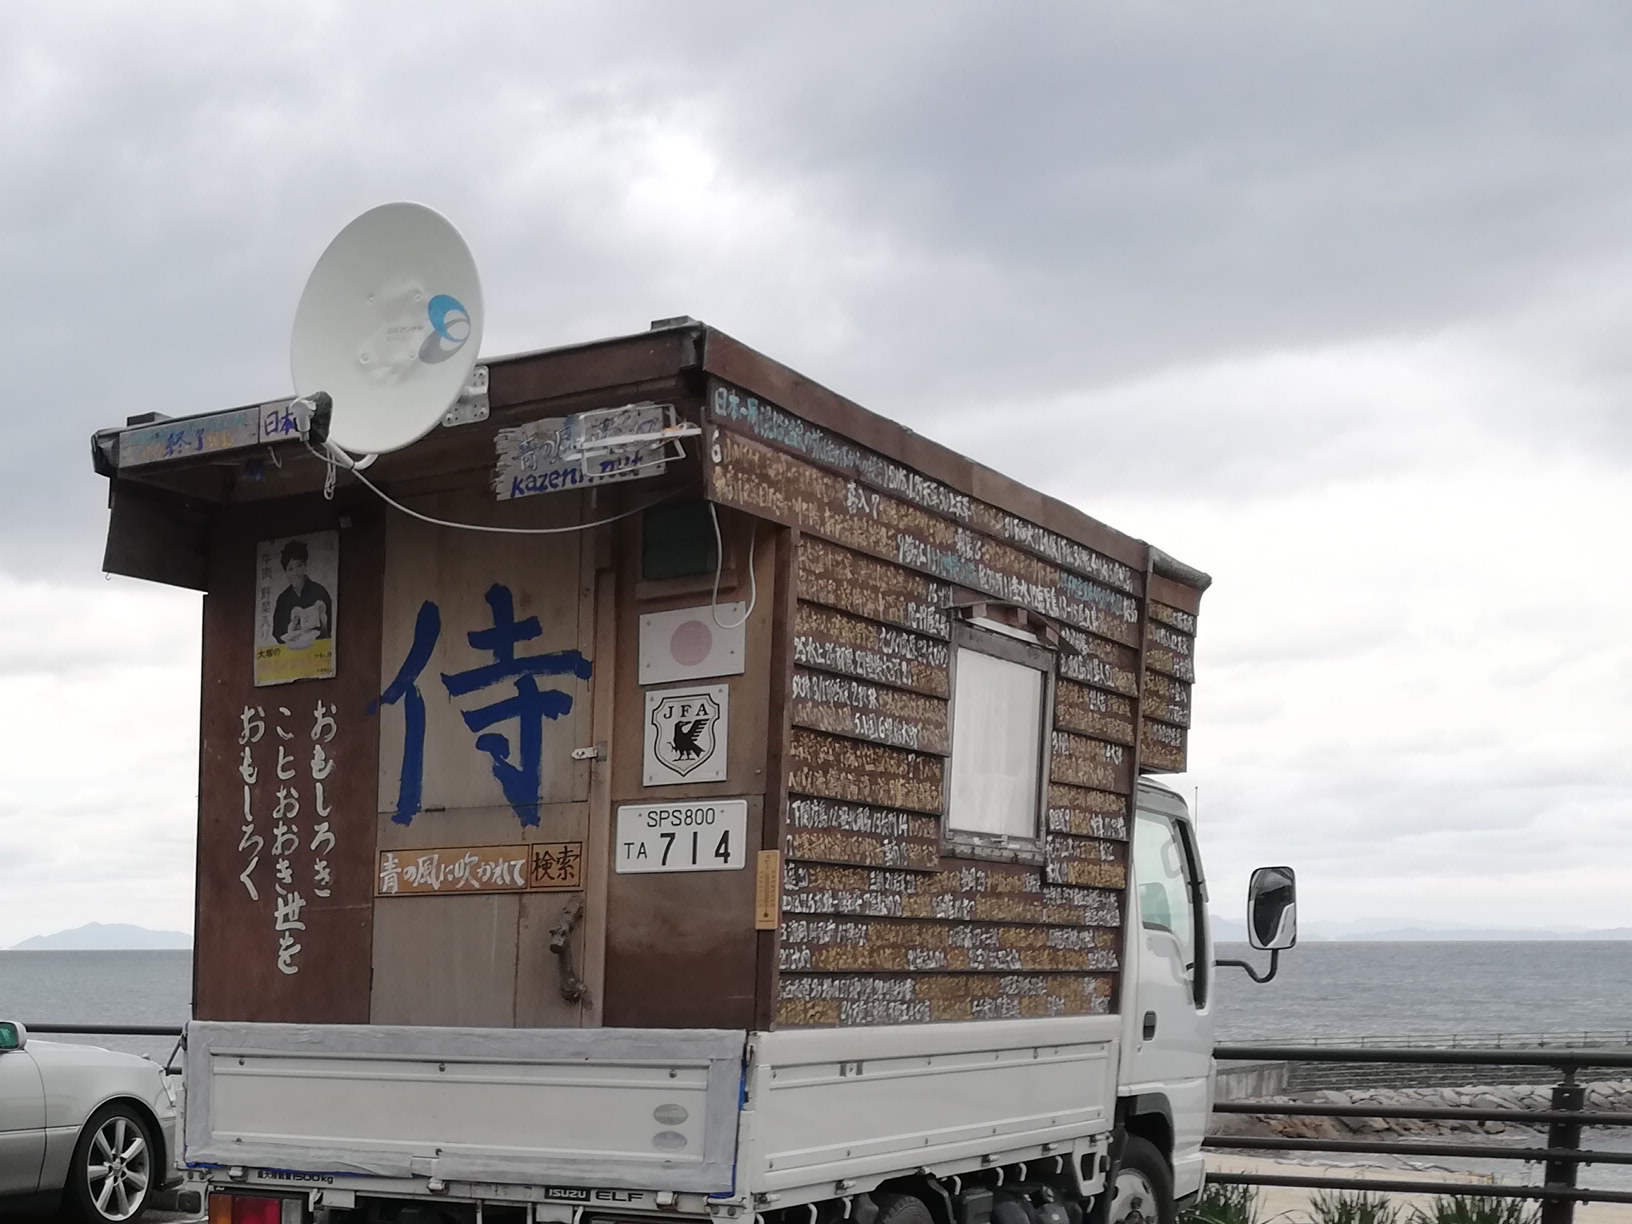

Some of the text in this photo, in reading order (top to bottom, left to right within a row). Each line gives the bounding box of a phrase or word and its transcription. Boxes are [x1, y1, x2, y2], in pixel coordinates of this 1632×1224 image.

[368, 583, 593, 827] 侍
[663, 703, 710, 720] JFA
[238, 705, 266, 900] おもしろく
[311, 700, 338, 897] おもしろき
[646, 807, 716, 828] SPS800
[272, 706, 307, 974] ことおおき世を
[623, 841, 648, 860] TA
[379, 844, 580, 895] 青の風に吹かれて 検索
[548, 1188, 644, 1203] ISUZU ELF
